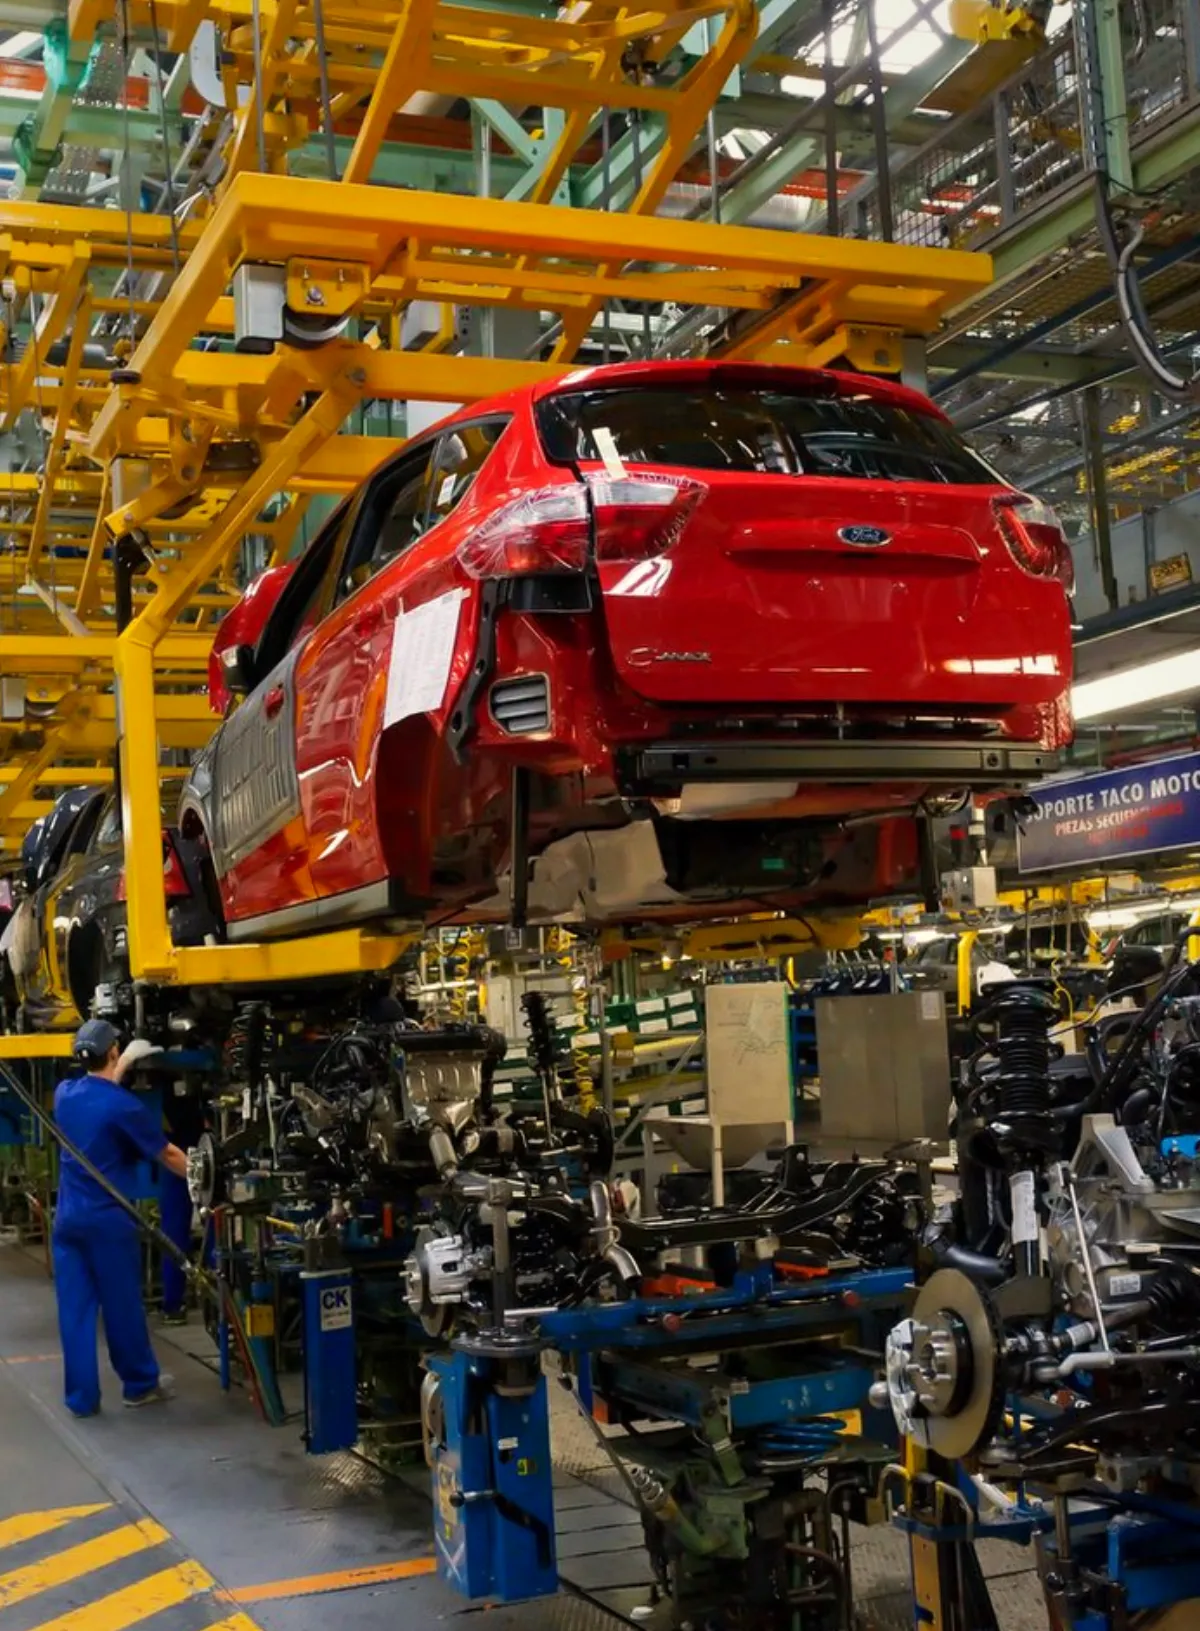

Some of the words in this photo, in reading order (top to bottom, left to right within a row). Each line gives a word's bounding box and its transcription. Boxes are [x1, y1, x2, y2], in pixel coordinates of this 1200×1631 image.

[1101, 783, 1143, 808] TACO
[1055, 818, 1093, 836] PIEZAS
[323, 1289, 349, 1309] CK
